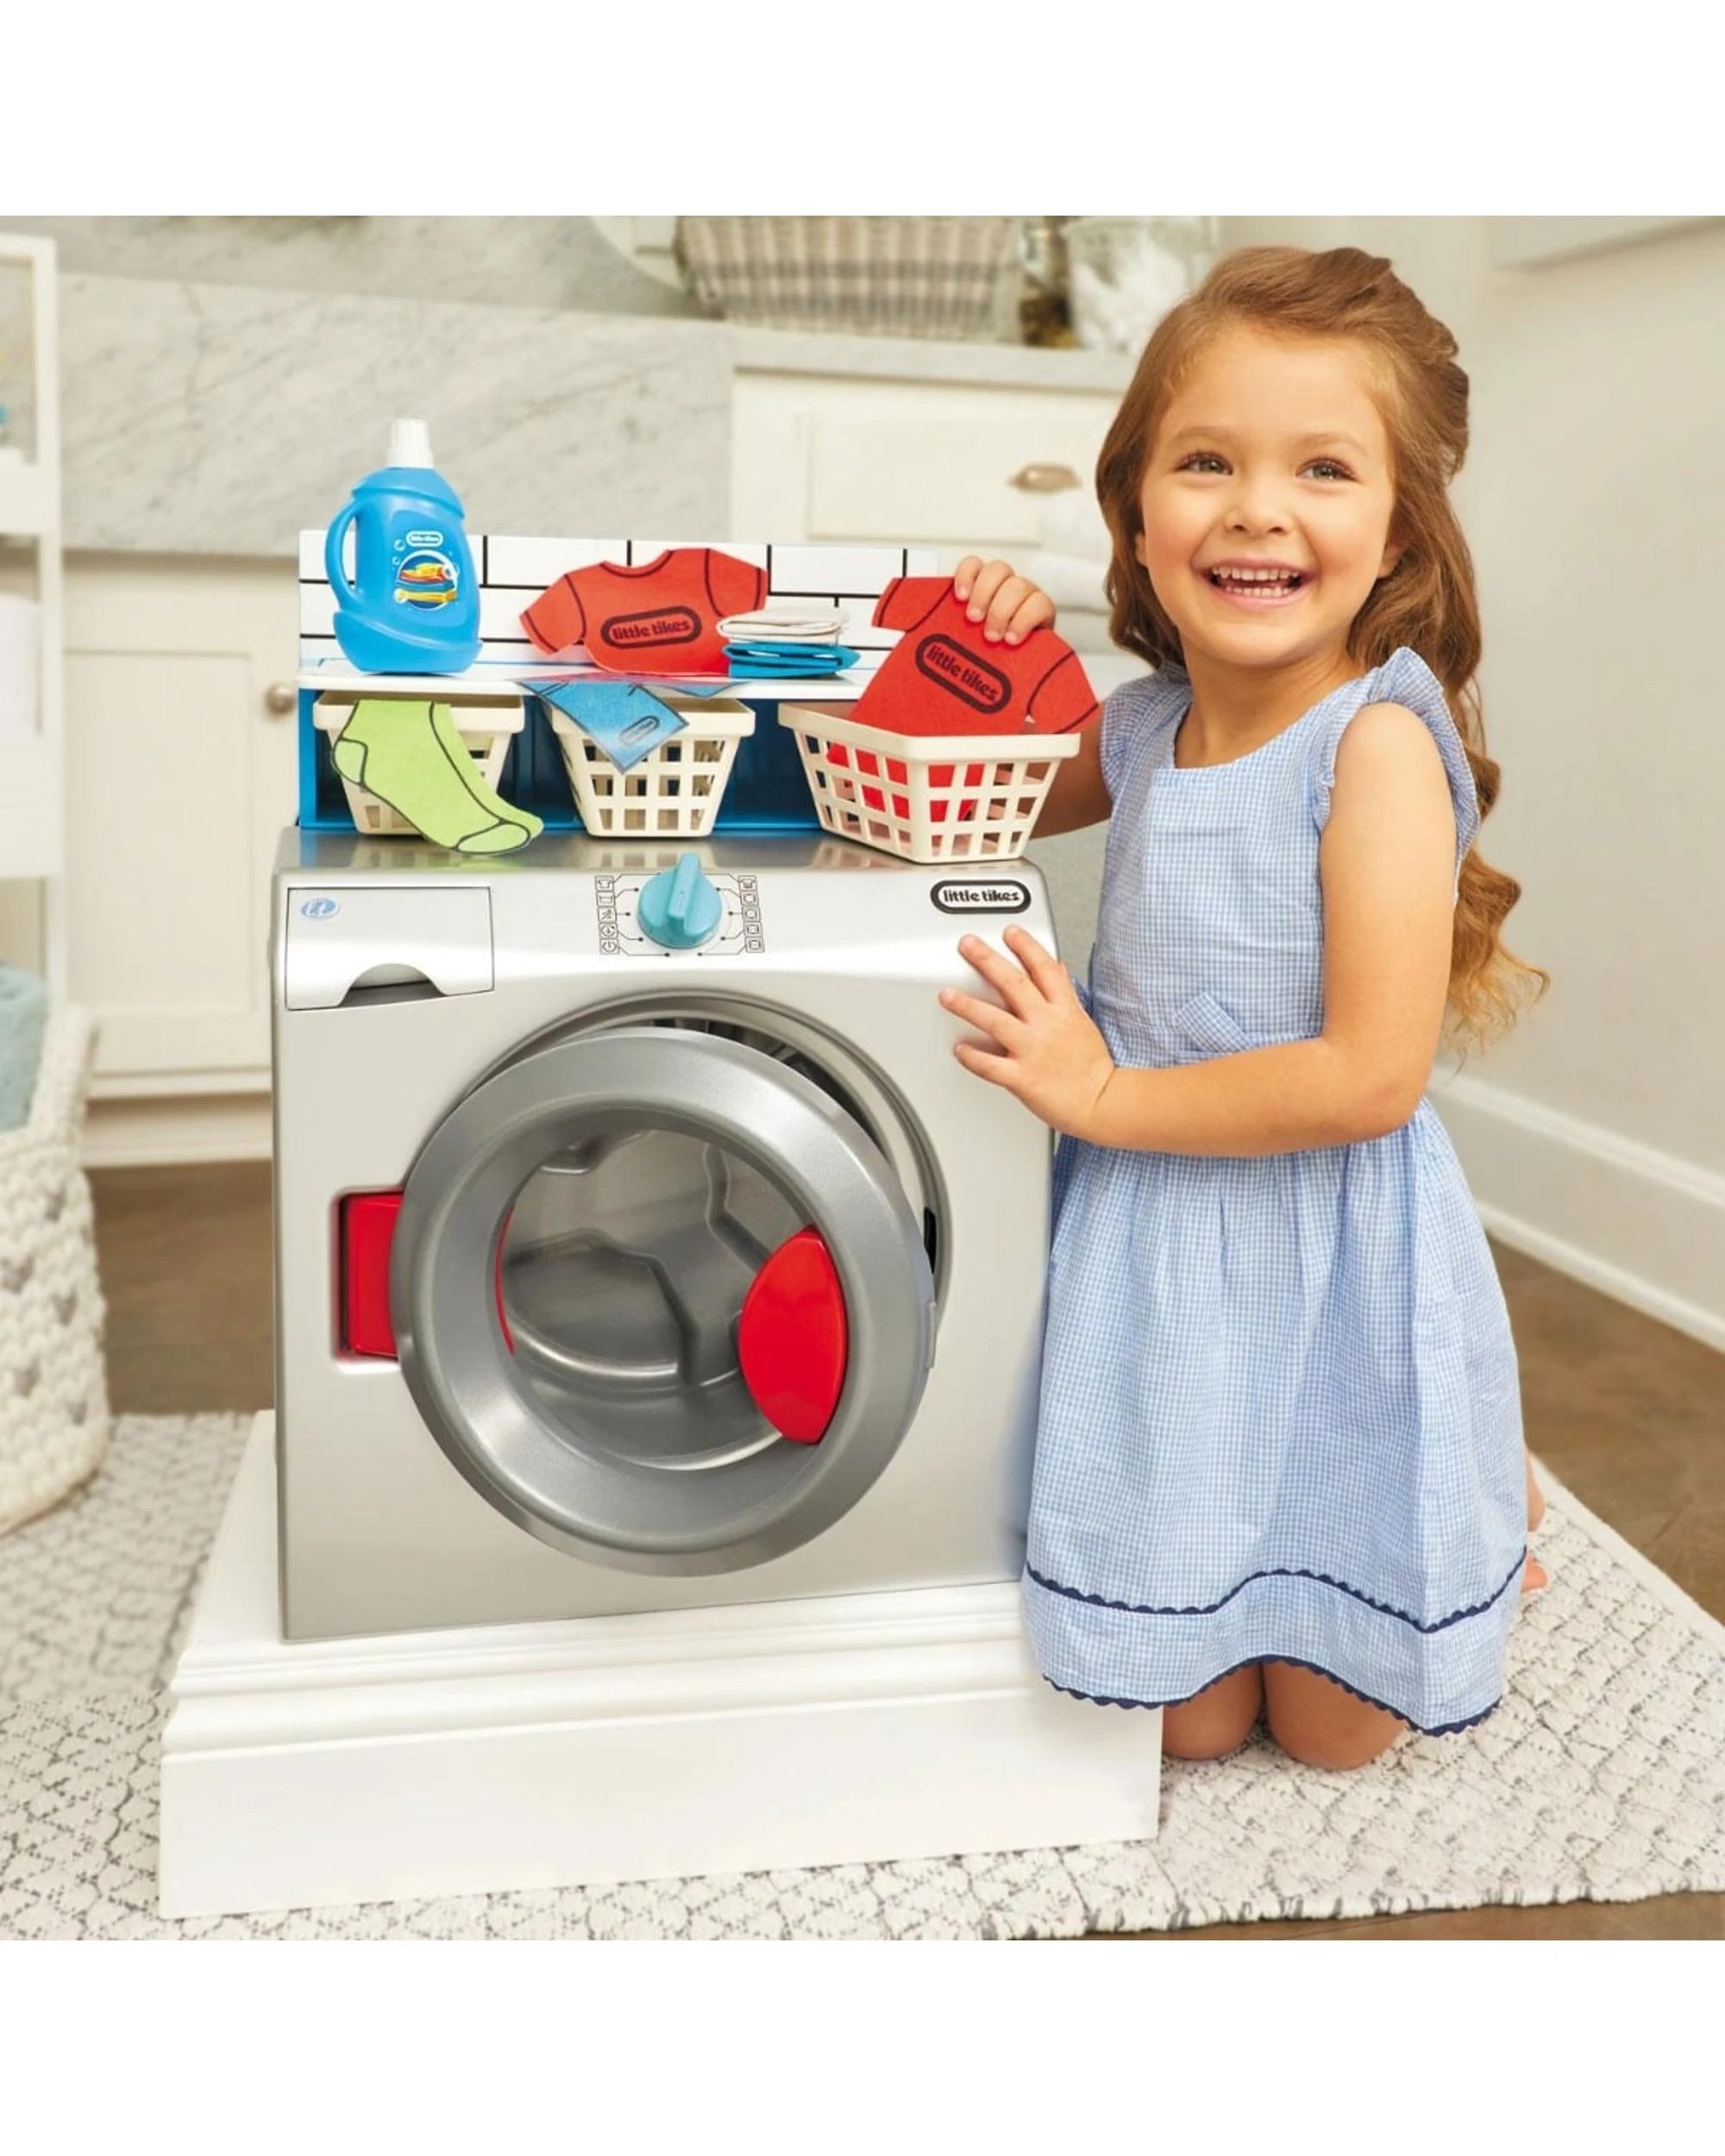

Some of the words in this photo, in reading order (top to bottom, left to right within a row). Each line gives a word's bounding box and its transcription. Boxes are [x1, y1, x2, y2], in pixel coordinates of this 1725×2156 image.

[612, 625, 650, 640] little
[651, 621, 690, 635] tikes
[926, 645, 961, 676] little
[961, 669, 998, 700] tikes
[943, 889, 981, 902] little
[982, 888, 1019, 902] tikes
